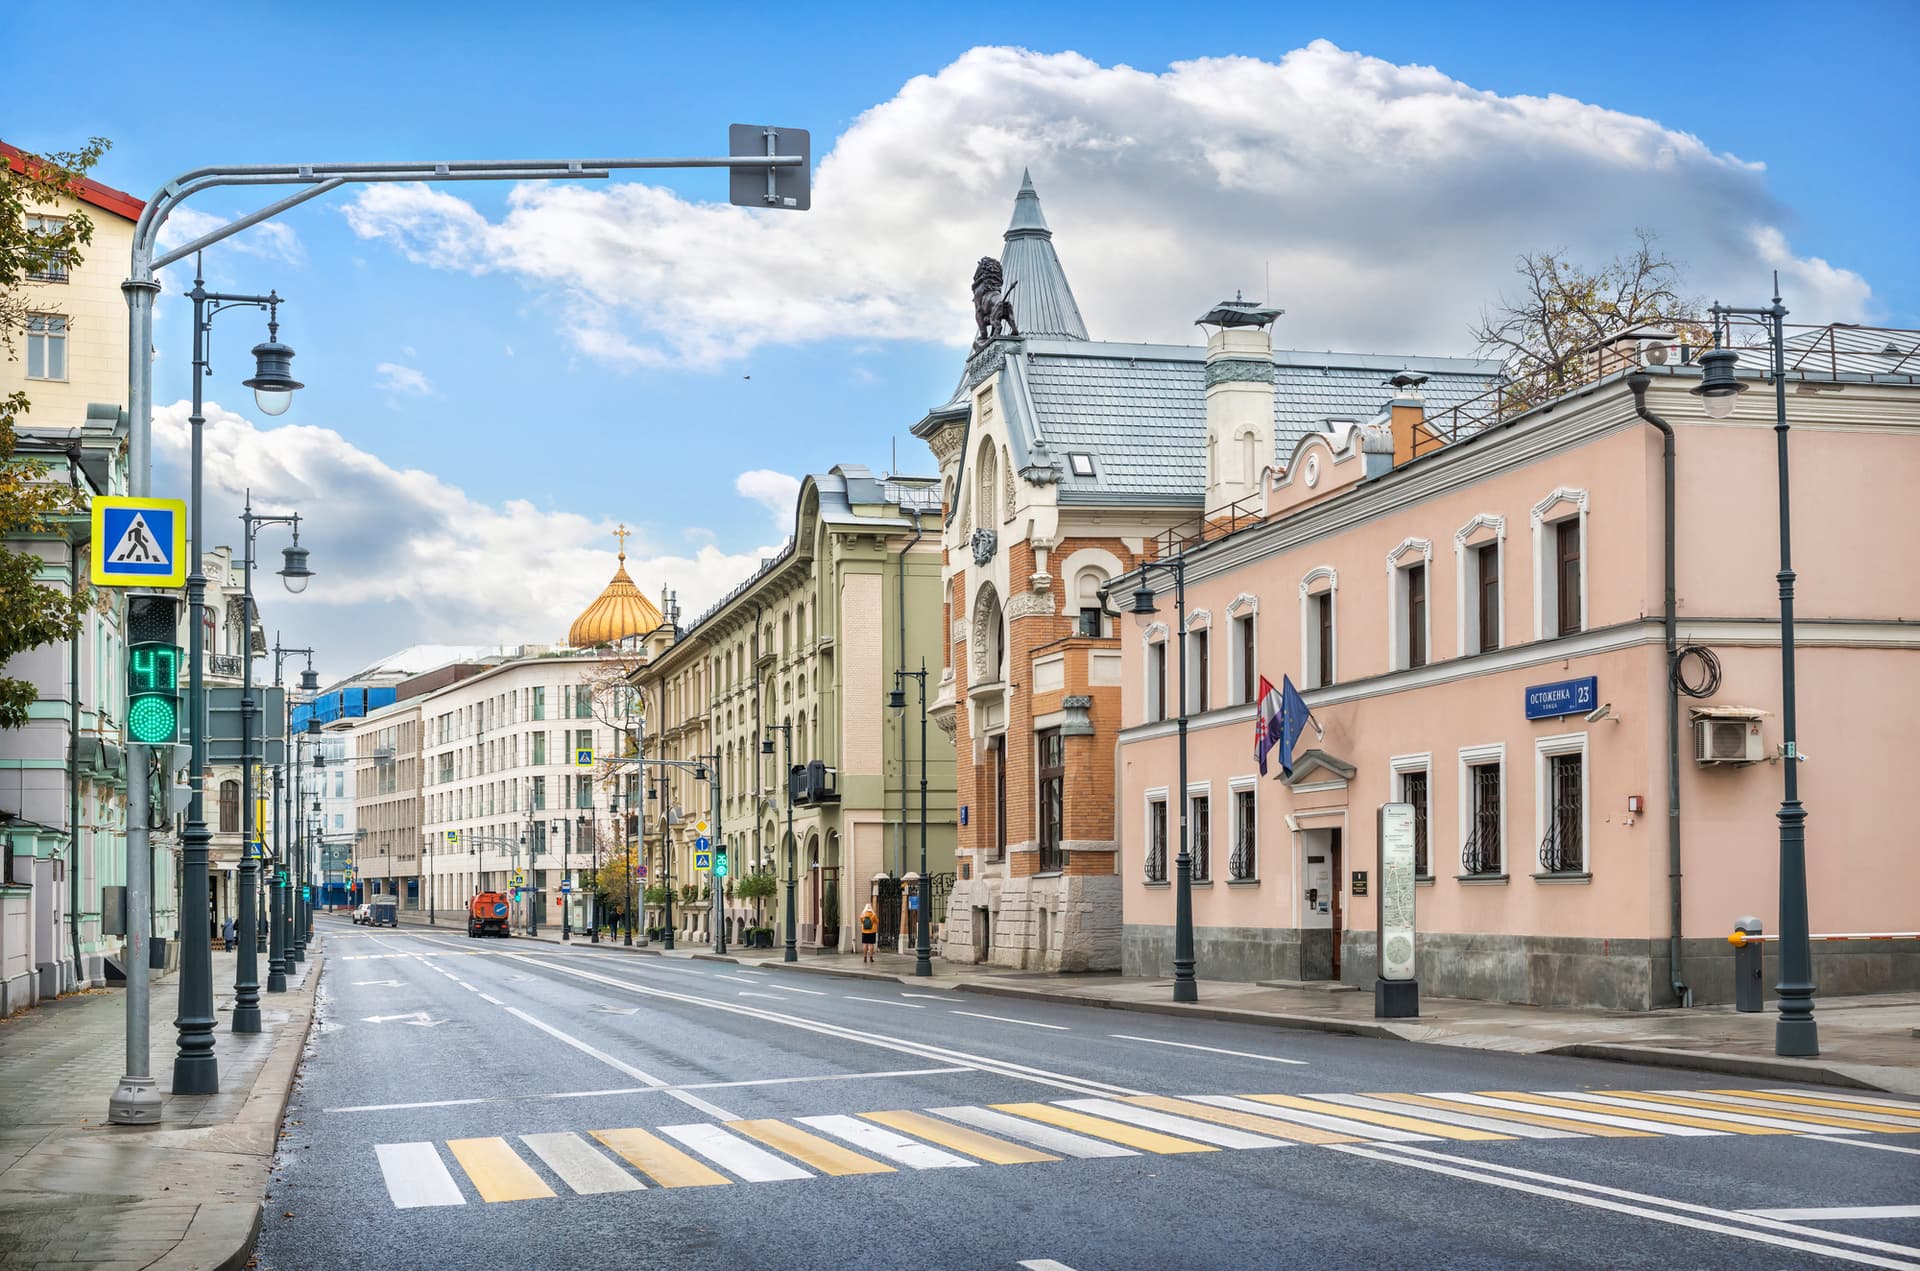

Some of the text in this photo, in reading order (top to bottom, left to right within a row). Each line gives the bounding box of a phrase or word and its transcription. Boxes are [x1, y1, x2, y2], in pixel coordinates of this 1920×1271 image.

[135, 650, 175, 689] 47
[1530, 689, 1570, 705] ОСТОЖЕНКА
[1578, 686, 1589, 703] 23
[717, 855, 727, 865] 26
